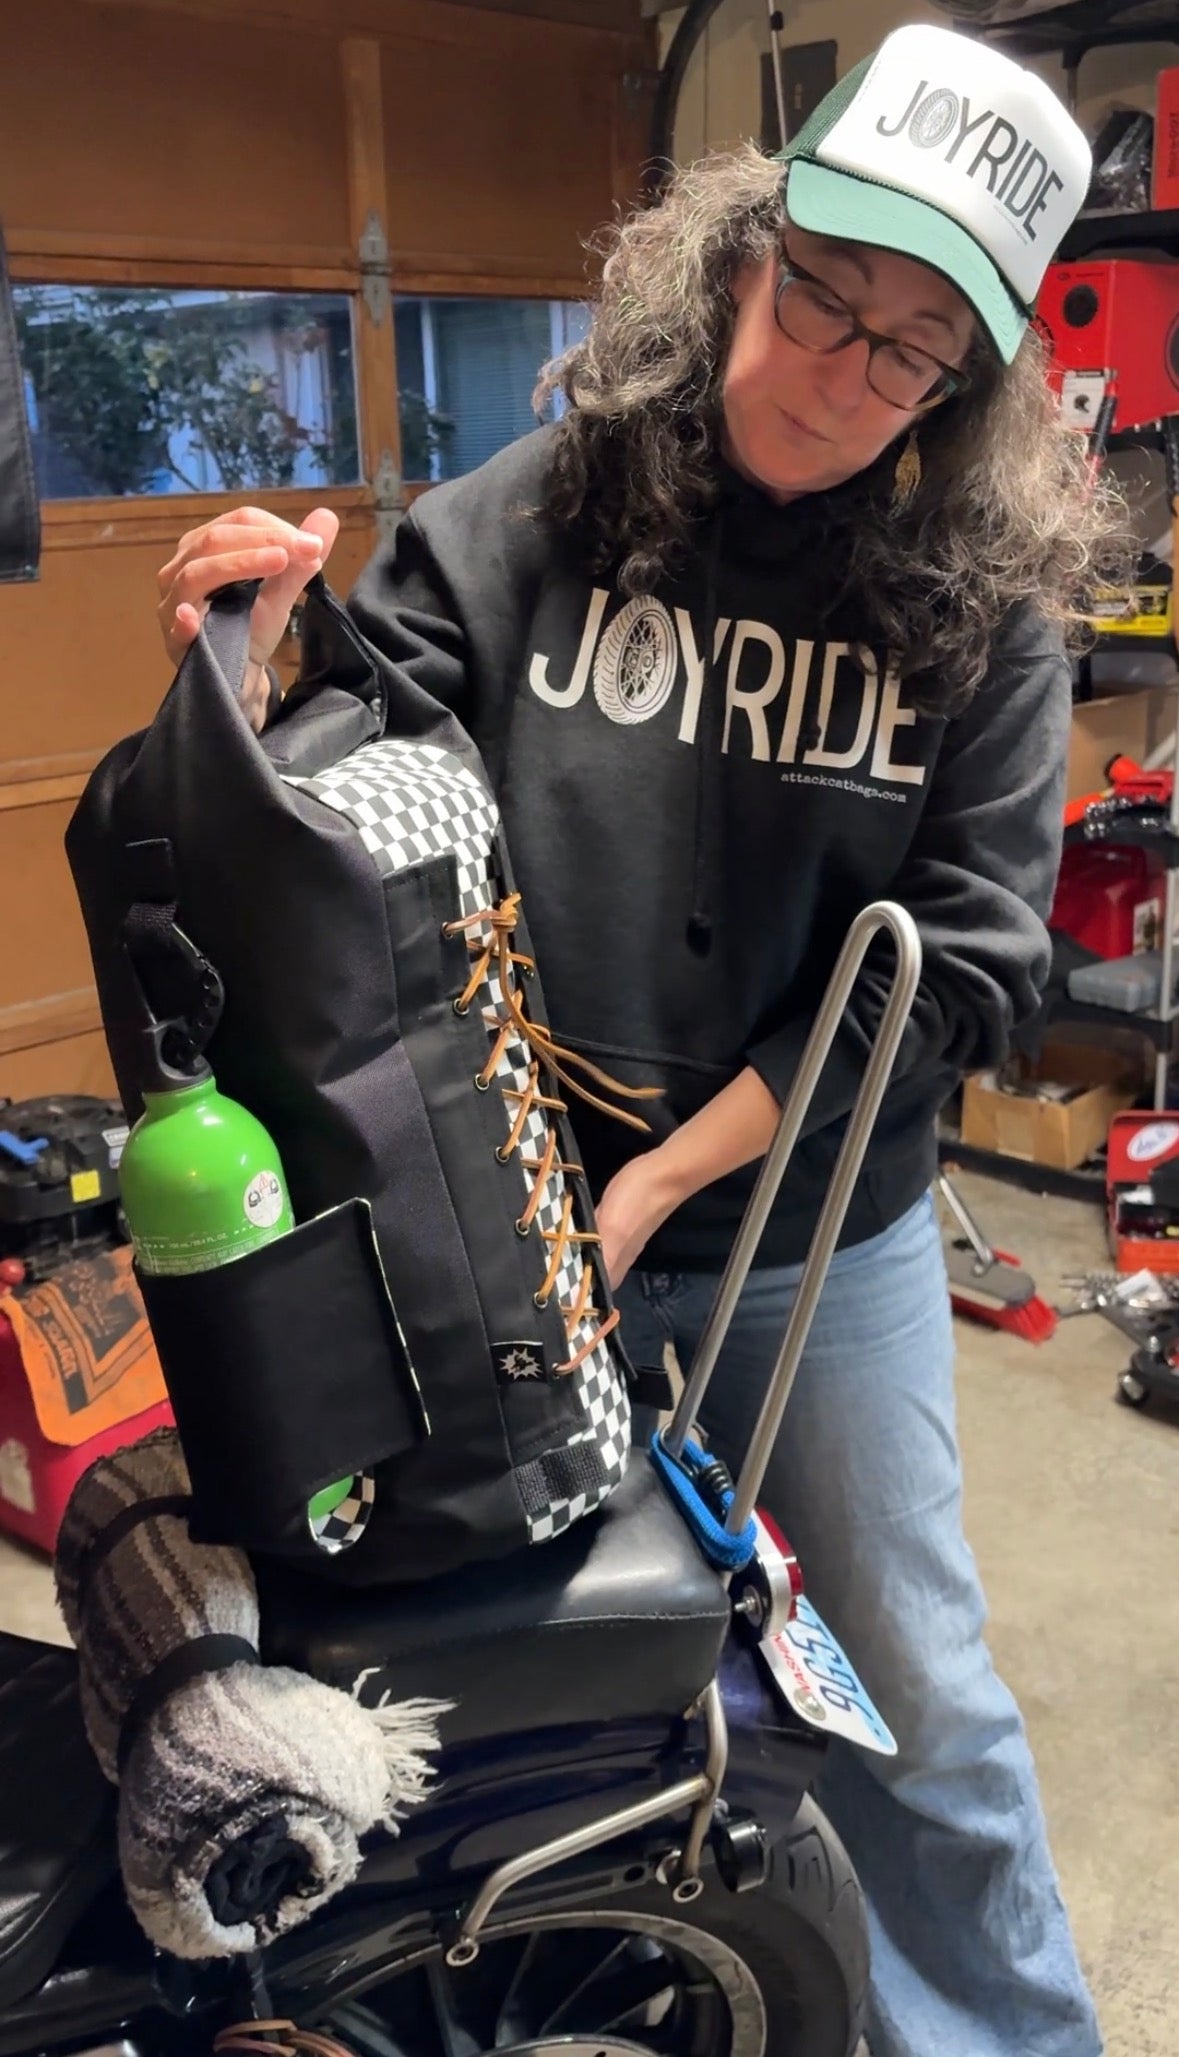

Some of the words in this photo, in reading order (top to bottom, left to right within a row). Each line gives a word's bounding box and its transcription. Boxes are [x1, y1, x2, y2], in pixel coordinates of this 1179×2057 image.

[876, 80, 1064, 241] JOYRIDE
[529, 587, 926, 785] JOYRIDE
[780, 773, 907, 803] attackcatbags.com
